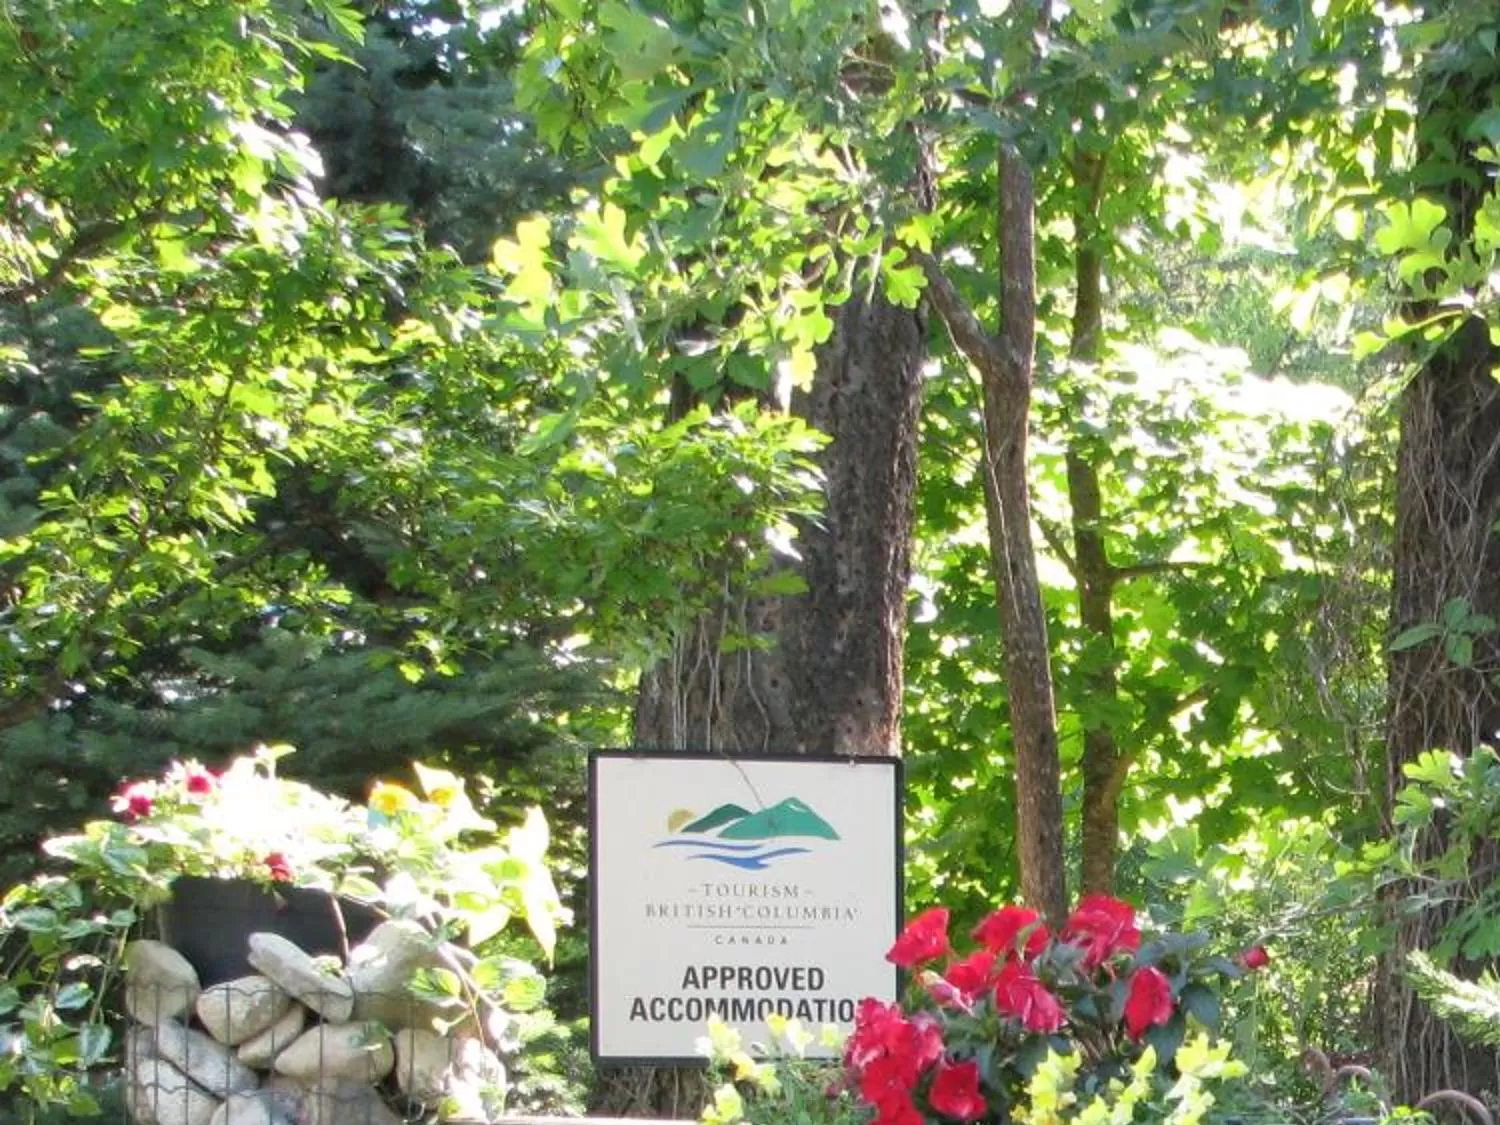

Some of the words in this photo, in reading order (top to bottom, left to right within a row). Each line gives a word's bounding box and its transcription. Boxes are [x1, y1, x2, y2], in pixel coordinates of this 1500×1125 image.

[703, 882, 800, 898] TOURISM
[714, 934, 789, 946] CANADA
[681, 965, 825, 991] APPROVED
[629, 996, 862, 1023] ACCOMMODATIO
